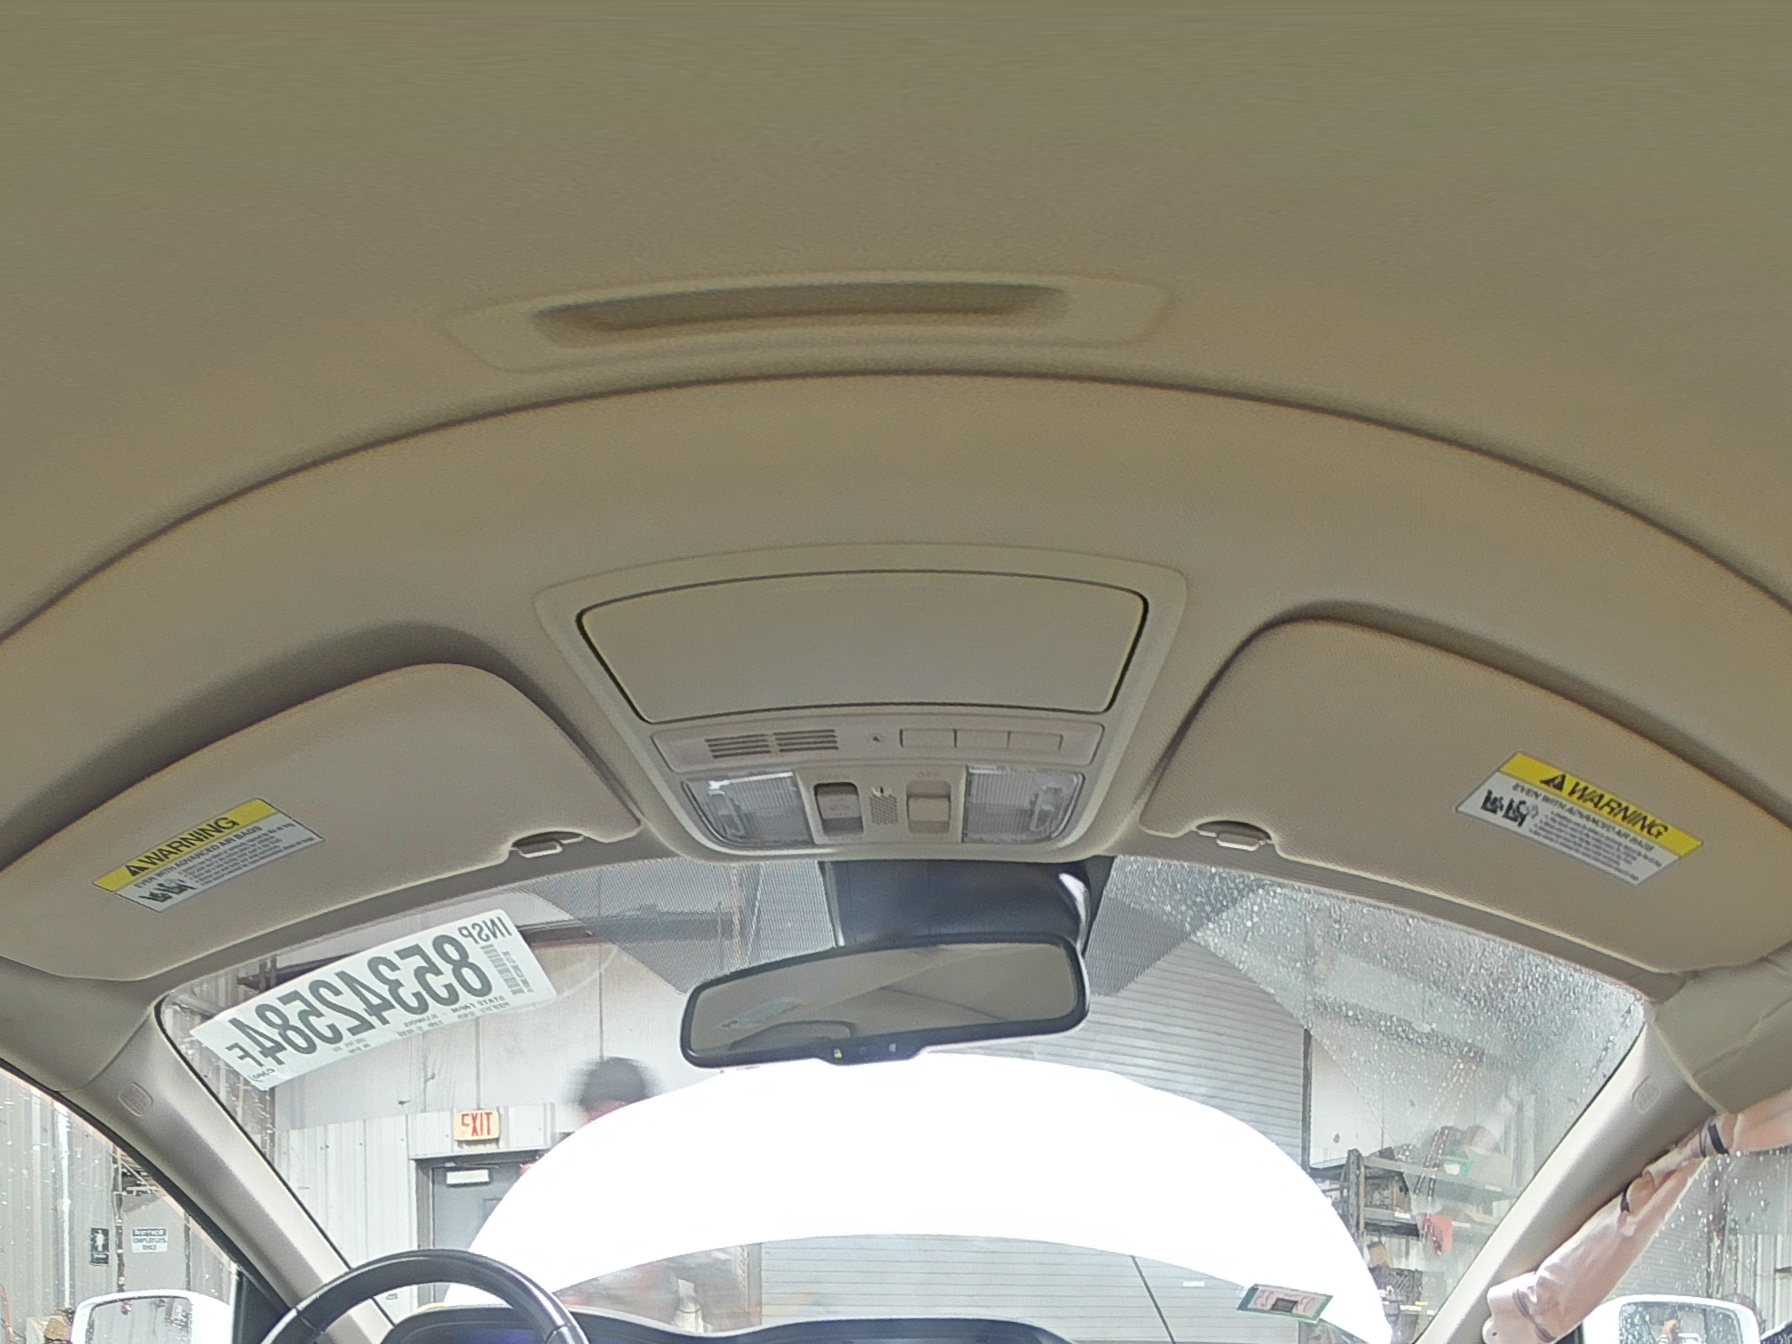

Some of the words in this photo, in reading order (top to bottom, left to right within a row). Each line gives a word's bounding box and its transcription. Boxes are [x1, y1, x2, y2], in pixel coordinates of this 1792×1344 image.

[1512, 783, 1541, 799] EVEN
[1567, 781, 1670, 840] WARNING
[137, 816, 240, 867] WARNING
[461, 1111, 493, 1137] EXIT
